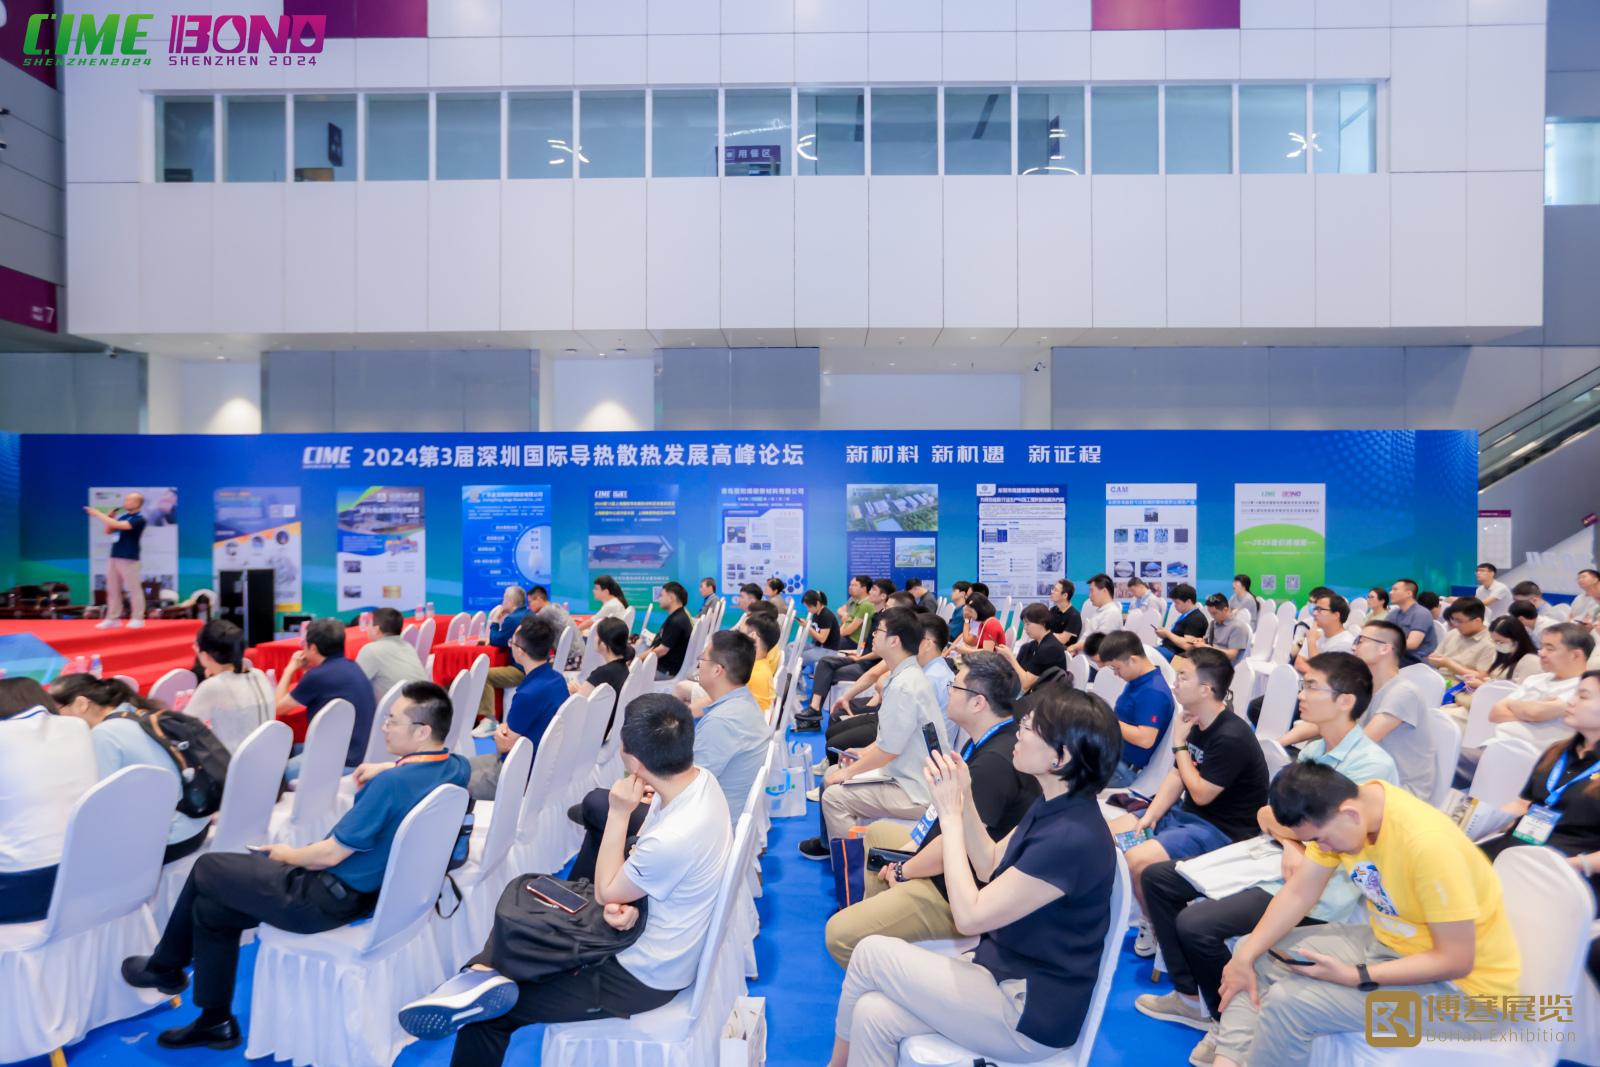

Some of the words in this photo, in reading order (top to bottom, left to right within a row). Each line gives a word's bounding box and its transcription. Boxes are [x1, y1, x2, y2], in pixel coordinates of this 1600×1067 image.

[738, 148, 771, 159] 用餐区
[45, 306, 55, 324] 7
[302, 446, 353, 464] CIME
[362, 442, 805, 468] 2024第3届深圳国际导热散热发展高峰论坛
[845, 444, 919, 464] 新材料
[931, 444, 1005, 464] 新机遇
[1028, 444, 1102, 464] 新征程
